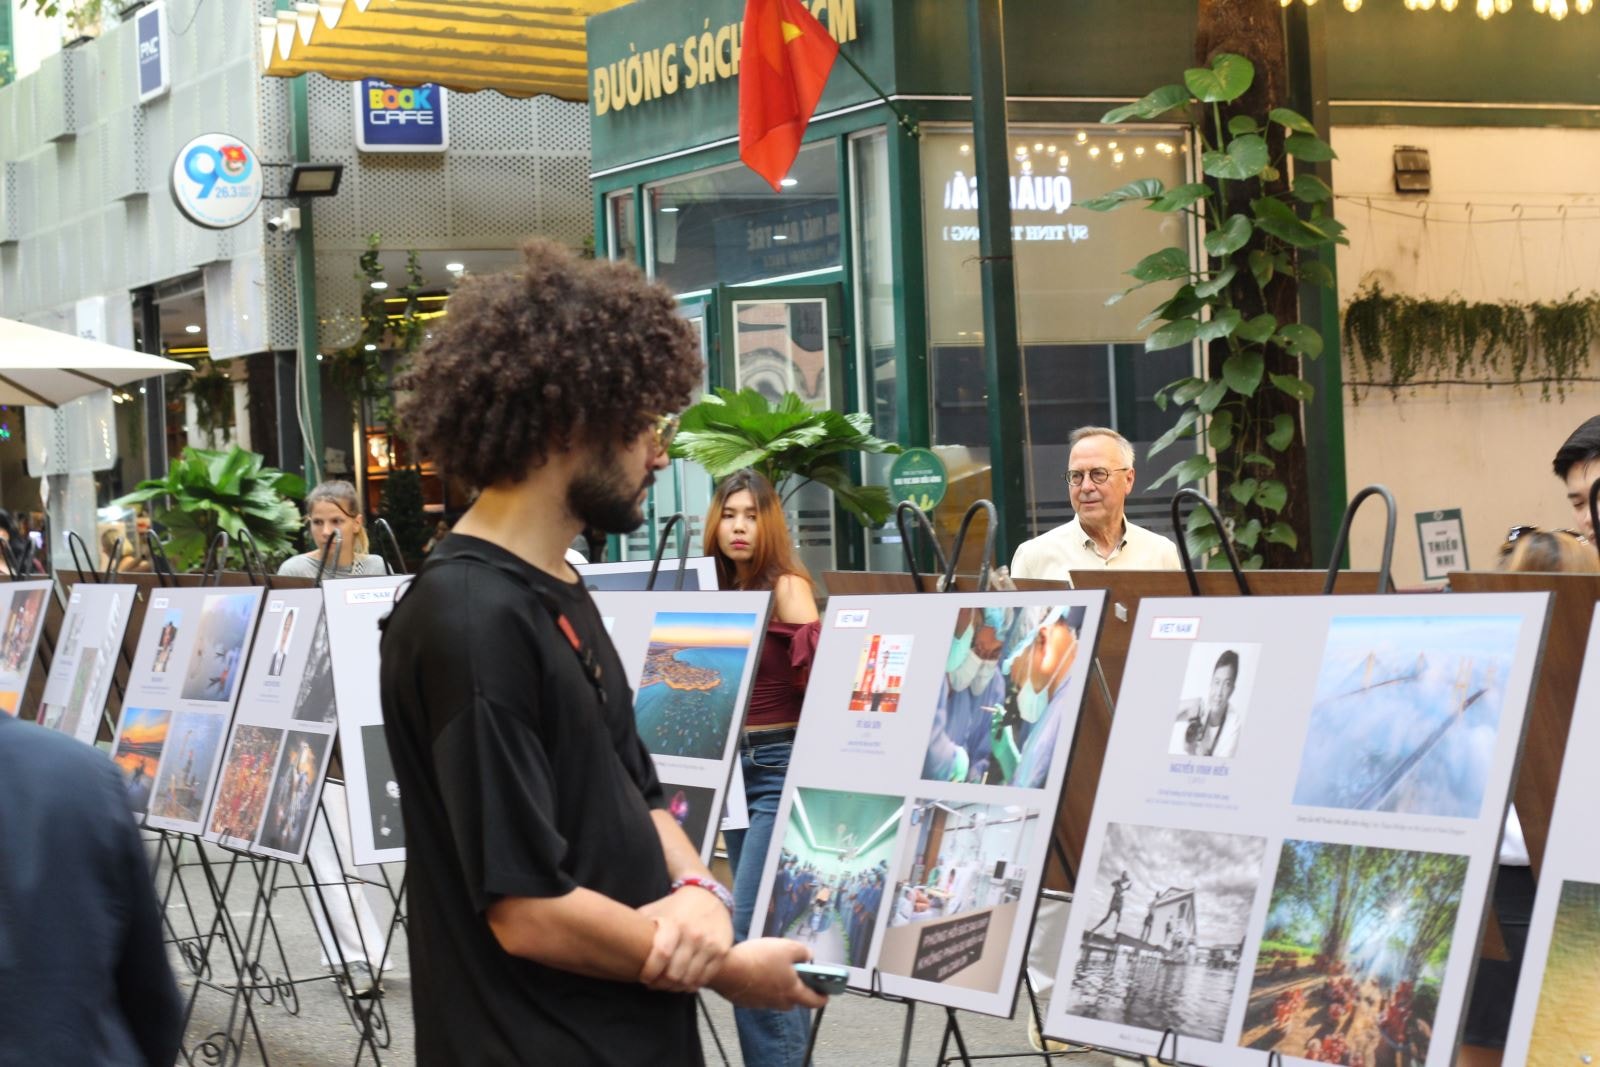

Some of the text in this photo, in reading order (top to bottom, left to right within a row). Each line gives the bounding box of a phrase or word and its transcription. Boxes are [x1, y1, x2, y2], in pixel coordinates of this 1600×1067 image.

[594, 42, 678, 116] ĐƯỜNG
[369, 88, 432, 109] BOOK
[370, 110, 434, 125] CAFE
